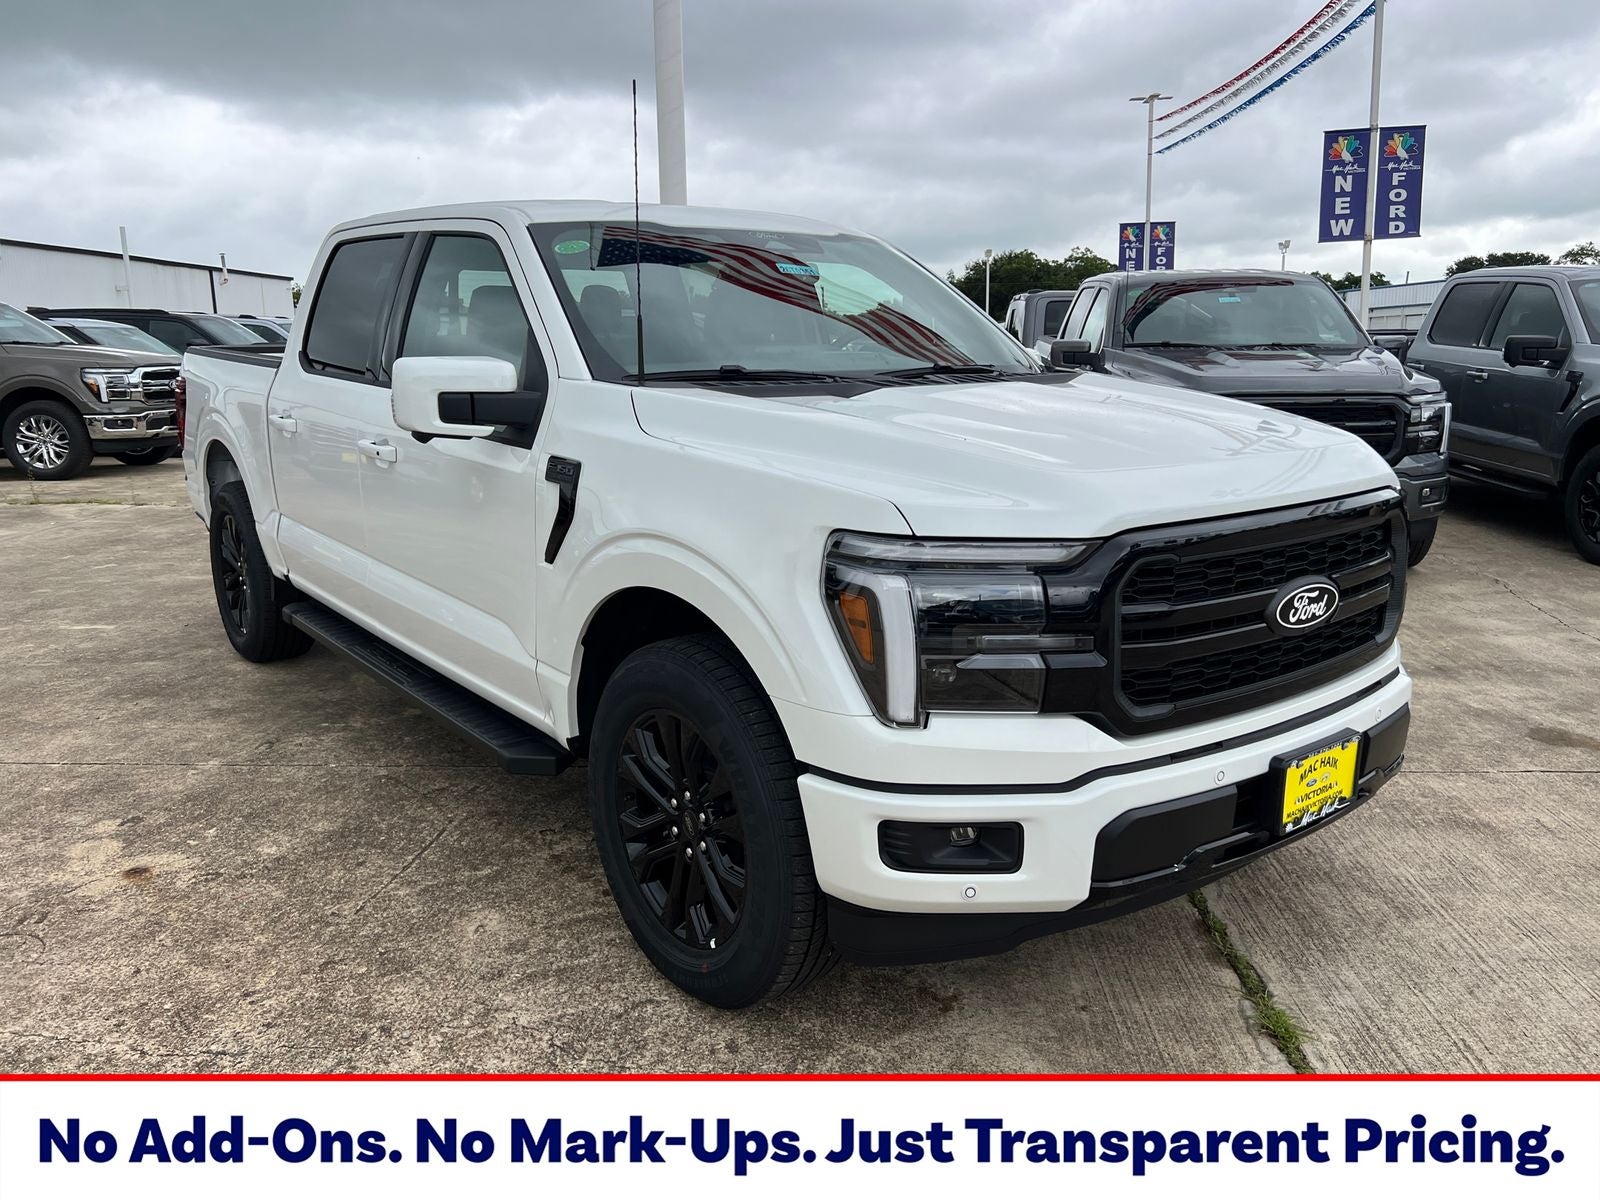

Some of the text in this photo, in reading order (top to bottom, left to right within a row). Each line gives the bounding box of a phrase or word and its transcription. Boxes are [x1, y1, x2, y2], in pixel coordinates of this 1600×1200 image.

[1330, 175, 1354, 236] NEW
[1389, 172, 1407, 234] FORD
[1125, 248, 1136, 271] NE
[1155, 247, 1167, 271] FO
[1289, 590, 1328, 623] Ford
[1299, 760, 1318, 784] MAC
[1320, 756, 1339, 770] HAIK
[1300, 782, 1333, 802] VICTORIA
